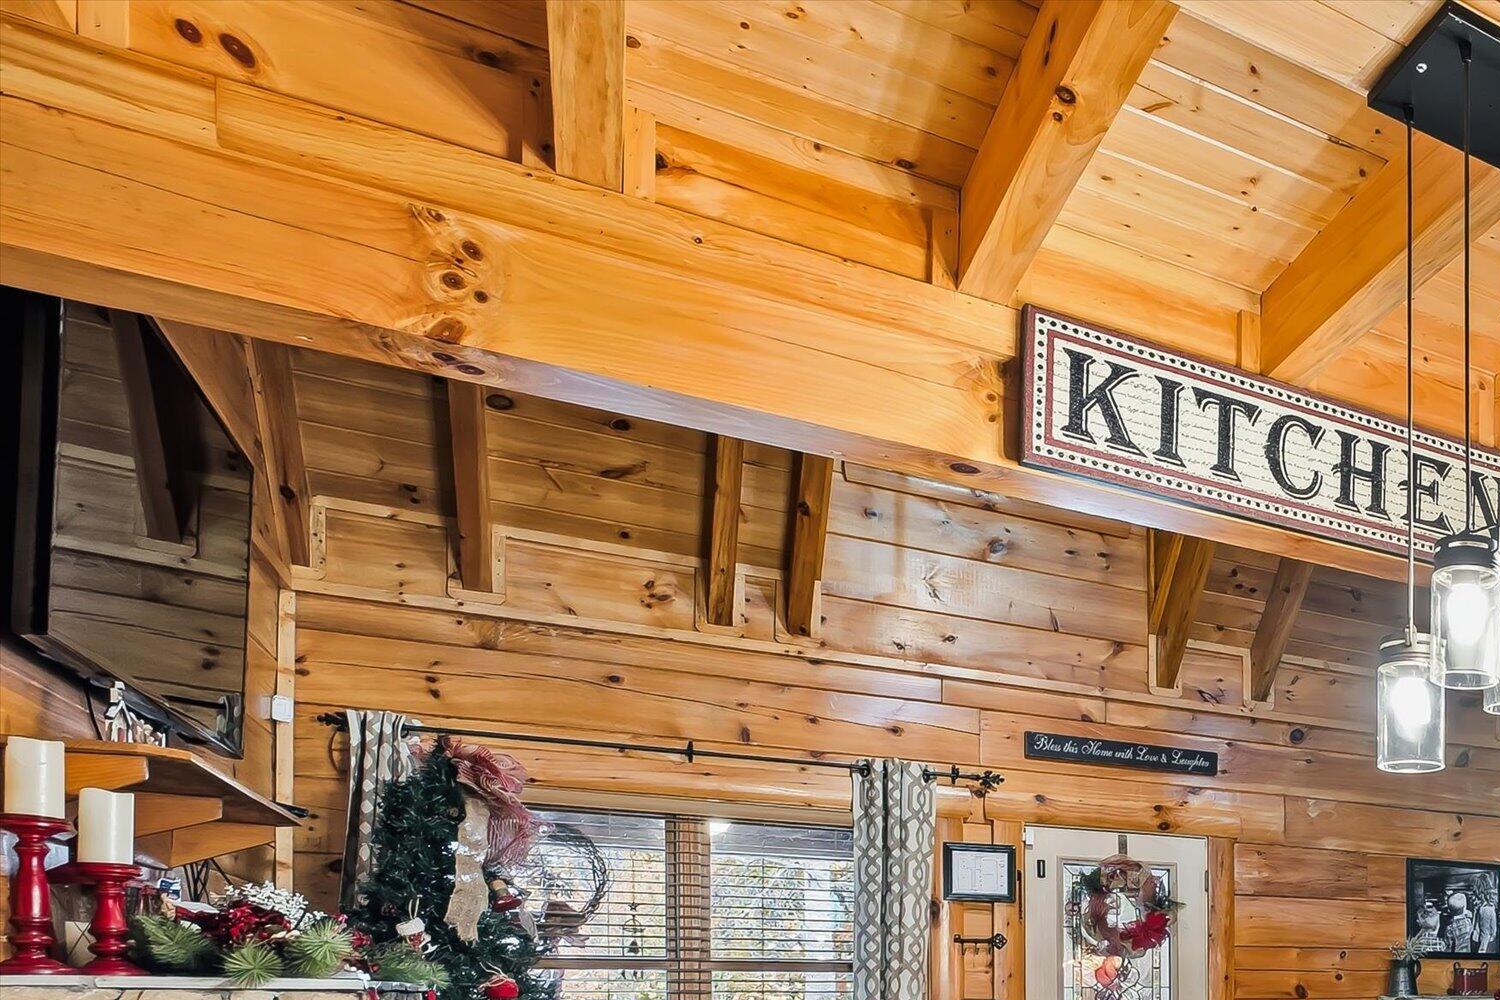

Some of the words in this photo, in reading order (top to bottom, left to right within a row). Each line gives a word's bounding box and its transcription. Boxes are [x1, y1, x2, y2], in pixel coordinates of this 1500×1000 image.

[1033, 734, 1061, 752] Bless
[1063, 740, 1078, 754] this
[1081, 740, 1113, 757] Home
[1114, 746, 1133, 760] with
[1135, 745, 1159, 761] Love
[1160, 753, 1167, 763] &
